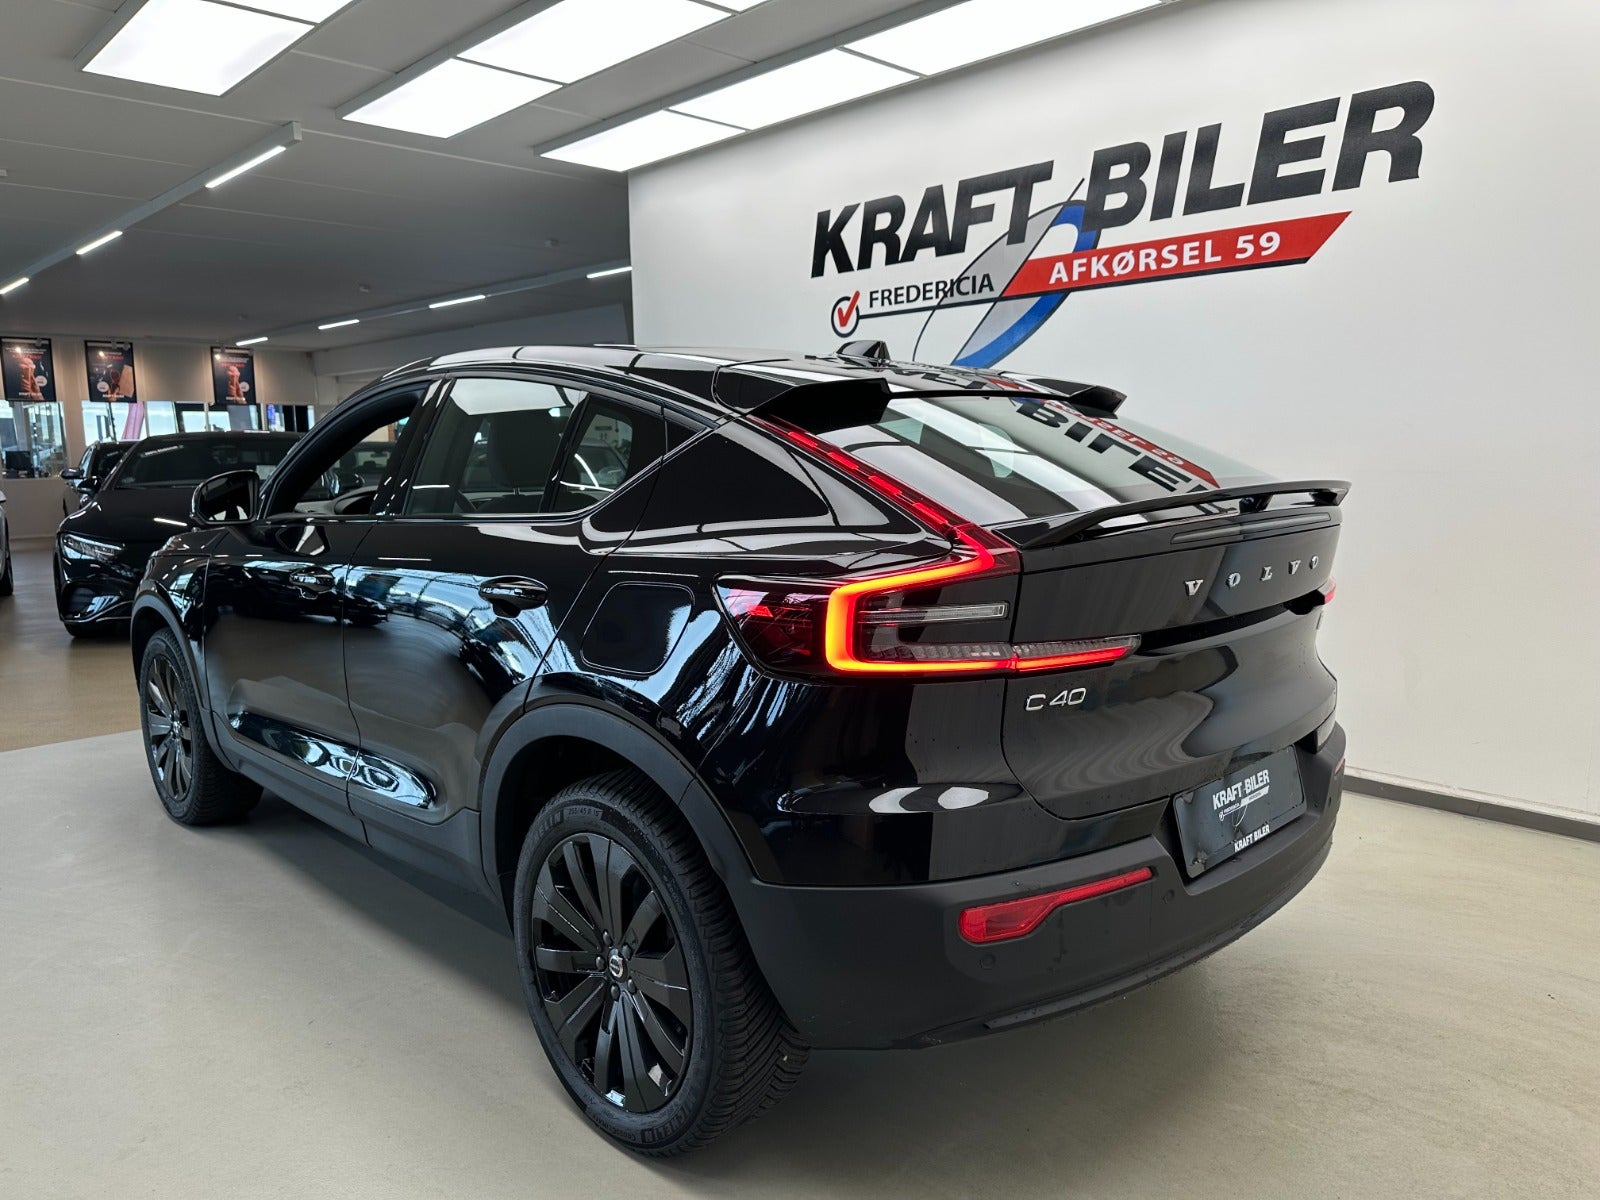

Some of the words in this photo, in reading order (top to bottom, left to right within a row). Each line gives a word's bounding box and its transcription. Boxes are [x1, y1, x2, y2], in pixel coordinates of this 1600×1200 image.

[810, 160, 1055, 279] KRAFT
[1081, 80, 1436, 234] BILER
[1049, 239, 1221, 284] AFKØRSEL
[1235, 232, 1281, 258] 59
[868, 273, 995, 309] FREDERICIA
[1184, 555, 1319, 596] VOLVO
[1212, 782, 1242, 810] KRAFT
[1245, 769, 1270, 794] BILER
[1234, 834, 1254, 853] KRAFT
[1254, 824, 1270, 841] BILER
